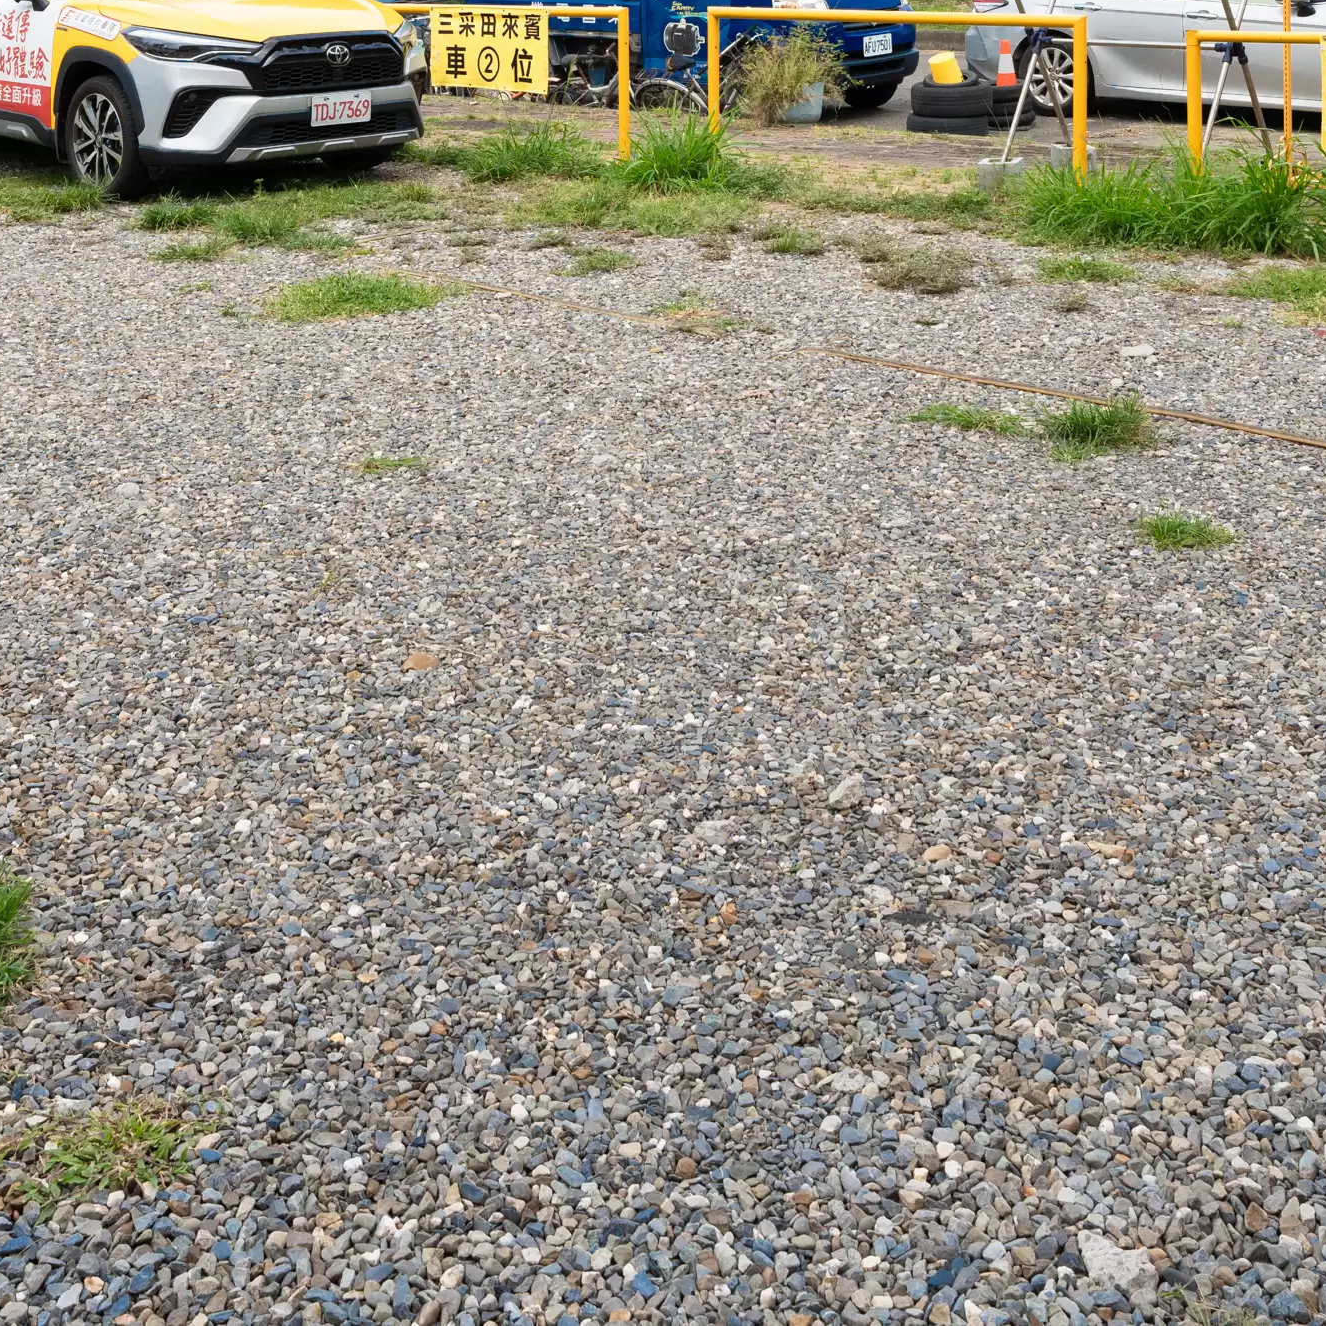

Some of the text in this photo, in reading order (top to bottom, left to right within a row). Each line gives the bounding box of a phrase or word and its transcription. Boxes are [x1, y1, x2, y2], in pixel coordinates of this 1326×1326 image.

[438, 11, 542, 41] 三采田來賓
